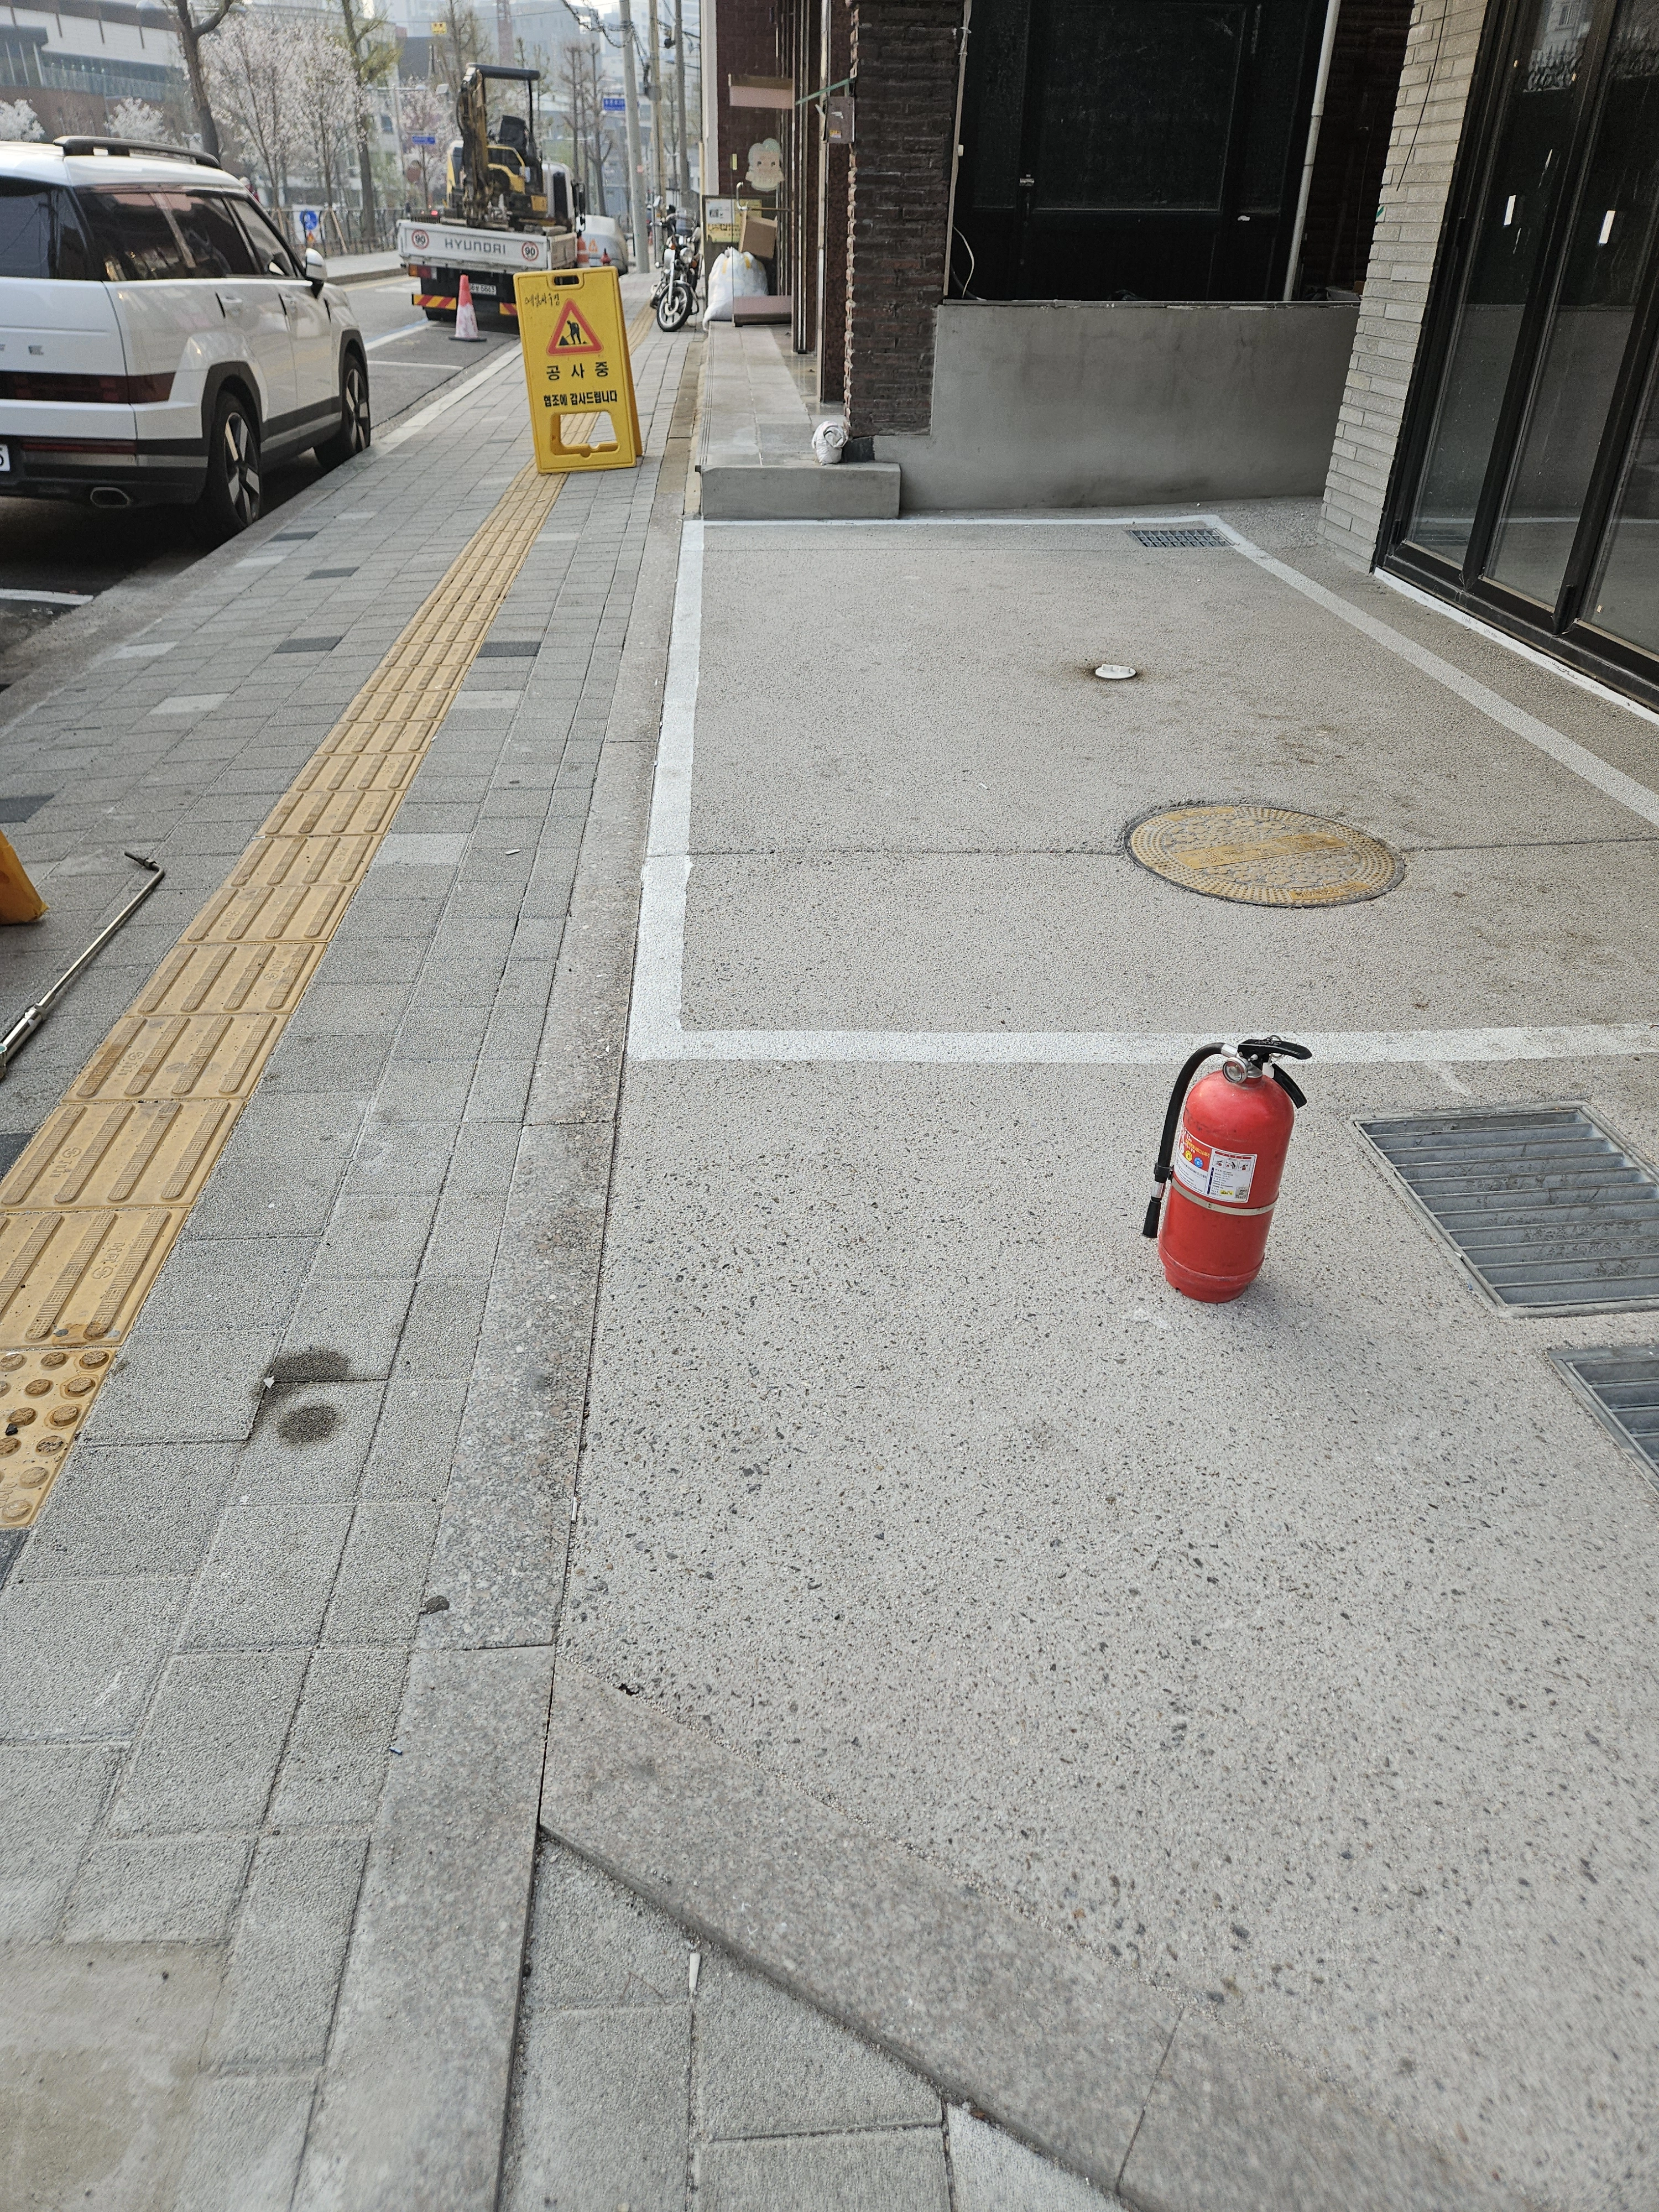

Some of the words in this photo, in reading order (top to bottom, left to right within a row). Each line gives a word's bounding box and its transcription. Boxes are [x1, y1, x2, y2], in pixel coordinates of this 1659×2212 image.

[415, 236, 426, 245] 90
[445, 238, 505, 254] HYUNDAI
[525, 247, 535, 256] 90
[546, 365, 560, 380] 공
[571, 363, 585, 378] 사
[595, 361, 609, 377] 중
[544, 393, 568, 407] 협조에
[570, 389, 618, 406] 감사드립니다
